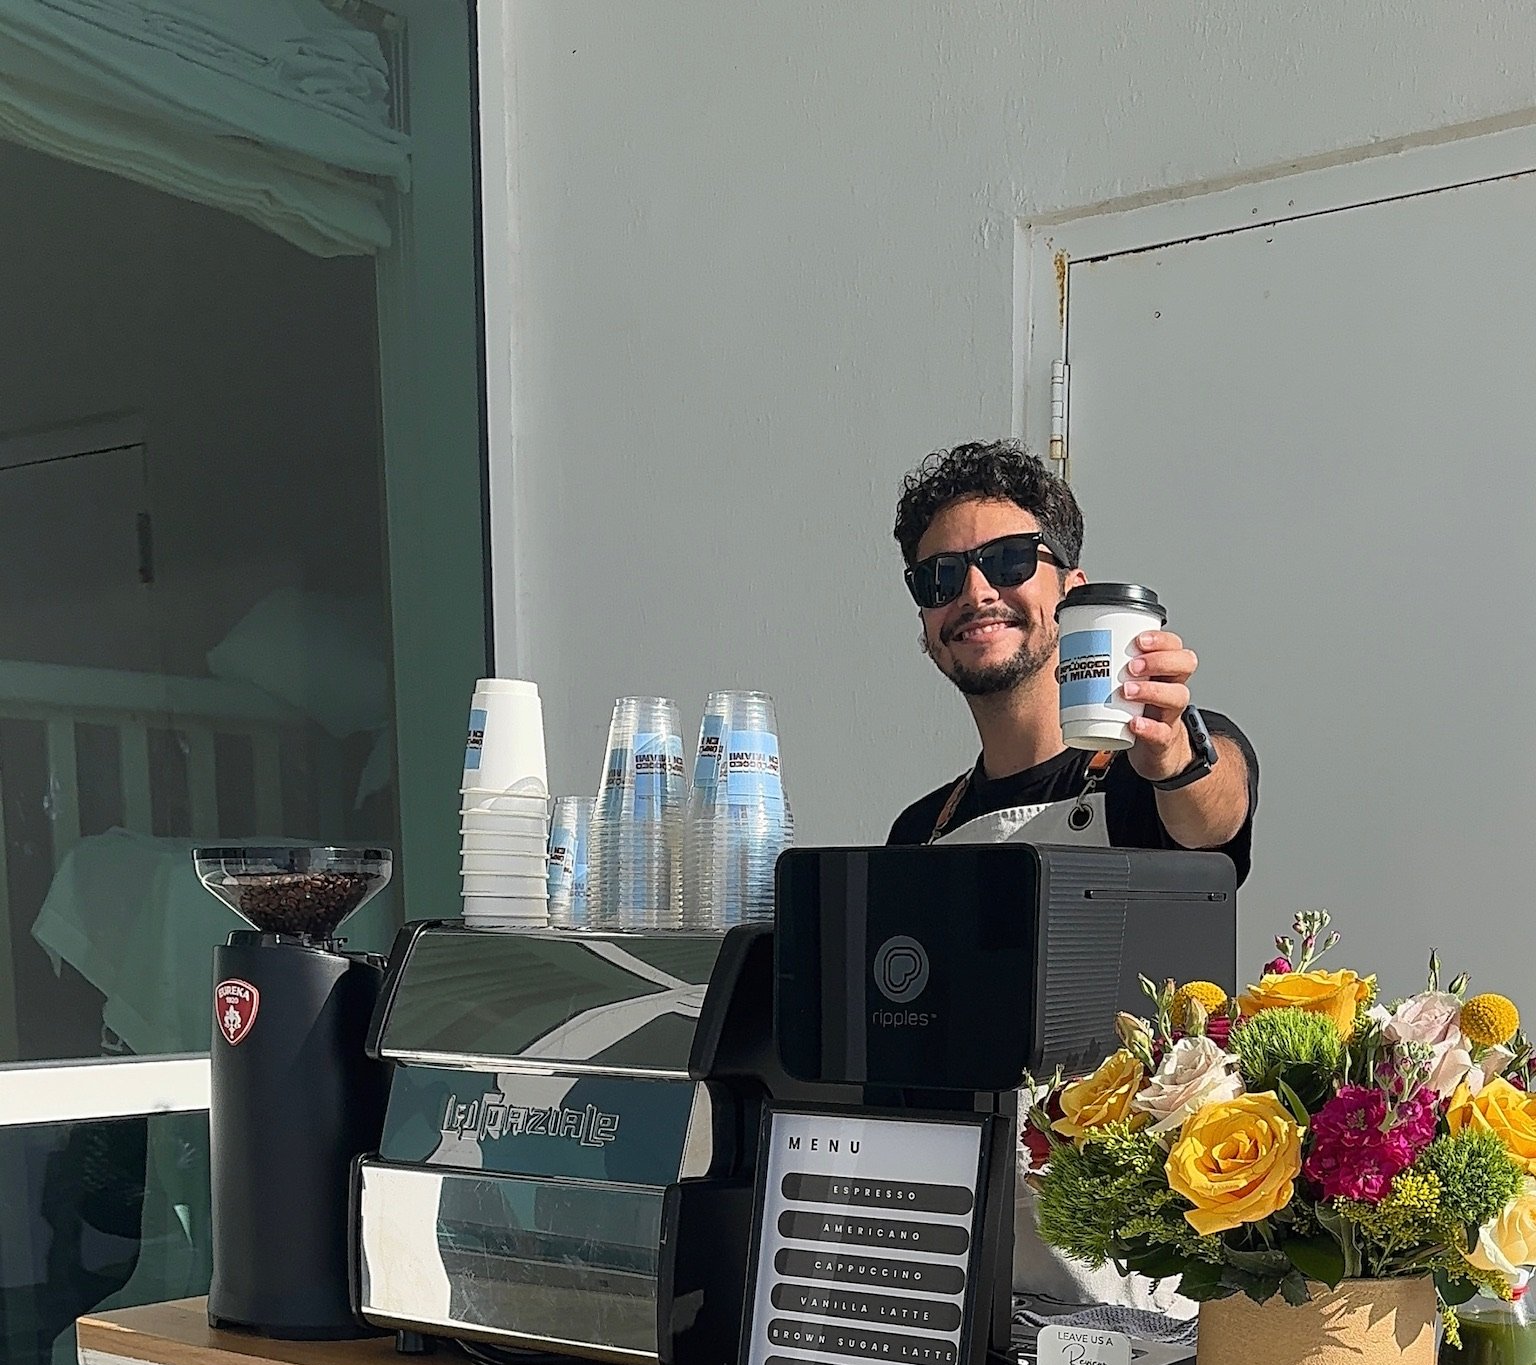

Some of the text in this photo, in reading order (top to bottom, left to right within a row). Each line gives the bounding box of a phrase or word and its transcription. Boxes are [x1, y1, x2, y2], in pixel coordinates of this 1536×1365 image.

[1070, 668, 1110, 682] MIAMI
[218, 985, 250, 1002] EUREKA
[788, 1136, 861, 1155] MENU
[833, 1185, 917, 1201] ESPRESSO
[823, 1223, 921, 1241] AMERICANO
[814, 1261, 923, 1281] CAPPUCCINO
[800, 1296, 930, 1321] VANILLA LATTE
[773, 1328, 952, 1361] BROWN SUGAR LATTE
[1058, 1331, 1114, 1346] LEAVE US A
